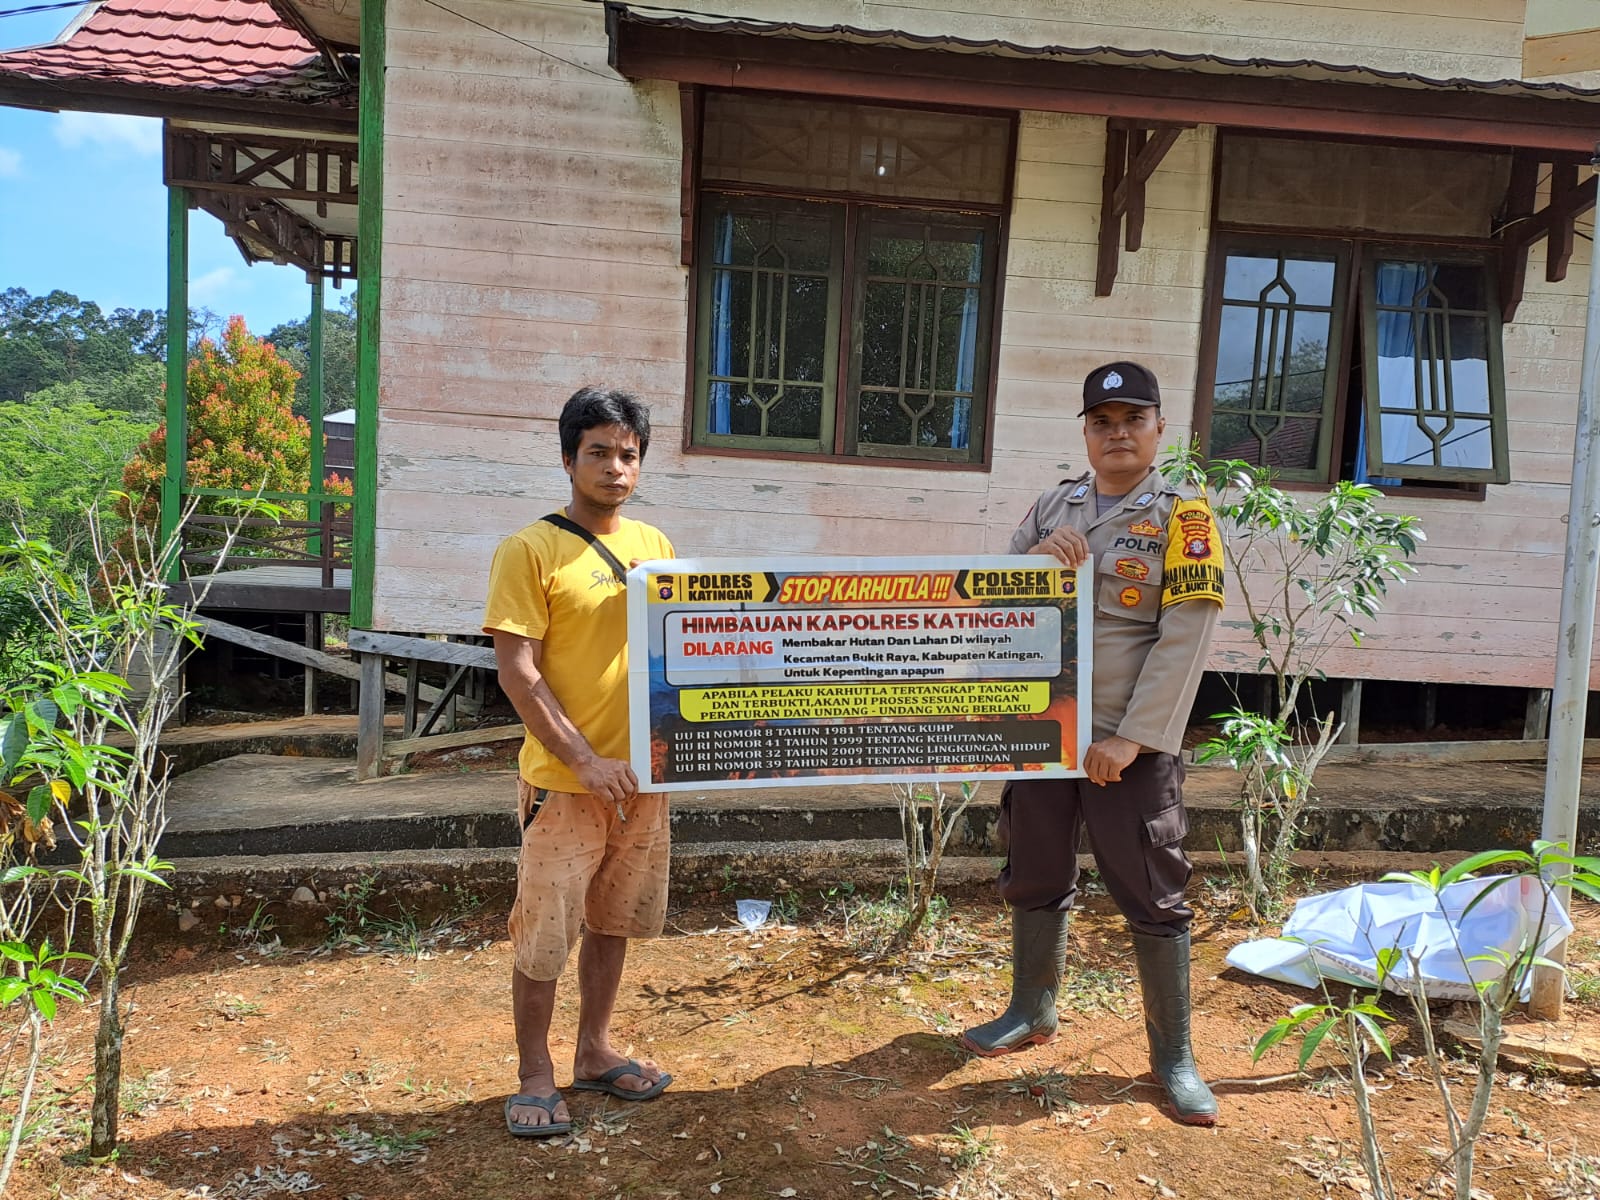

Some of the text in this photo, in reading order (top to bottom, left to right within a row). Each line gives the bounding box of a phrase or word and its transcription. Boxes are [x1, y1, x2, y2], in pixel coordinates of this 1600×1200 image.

[1114, 537, 1163, 555] POLRI
[688, 574, 753, 590] POLRES
[973, 571, 1051, 587] POLSEK
[688, 589, 753, 601] KATINGAN
[780, 577, 829, 602] STOP
[831, 574, 930, 601] KARHUTLA
[681, 611, 1036, 634] HIMBAUAN KAPOLRES KATINGAN
[683, 641, 774, 657] DILARANG
[782, 634, 1012, 648] Membakar Hutan Dan Lahan Di wilayah
[783, 650, 1044, 664] Kecamatan Bukit Raya, Kabupaten Katingan,
[784, 666, 945, 680] Untuk Kepentingan apapun
[702, 683, 1029, 700] APABILA PELAKU KARHUTLA TERTANGKAP TANGAN
[712, 700, 740, 710] DAN
[853, 697, 867, 706] DI
[871, 695, 920, 705] PROSES
[921, 694, 965, 704] SESUAI
[968, 693, 1020, 703] DENGAN
[700, 709, 781, 721] PERATURAN
[783, 708, 812, 718] DAN
[815, 707, 869, 717] UNDANG
[878, 705, 935, 716] UNDANG
[936, 704, 970, 714] YANG
[972, 703, 1031, 714] BERLAKU
[675, 723, 955, 741] UU RI NOMOR 8 TAHUN 1981 TENTANG KUHP
[675, 733, 1003, 752] UU RI NOMOR 41 TAHUN 1999 TENTANG KEHUTANAN
[675, 742, 1051, 763] UU RI NOMOR 32 TAHUN 2009 TENTANG LINGKUNGAN HIDUP
[675, 754, 1011, 774] UU RI NOMOR 39 TAHUN 2014 TENTANG PERKEBUNAN
